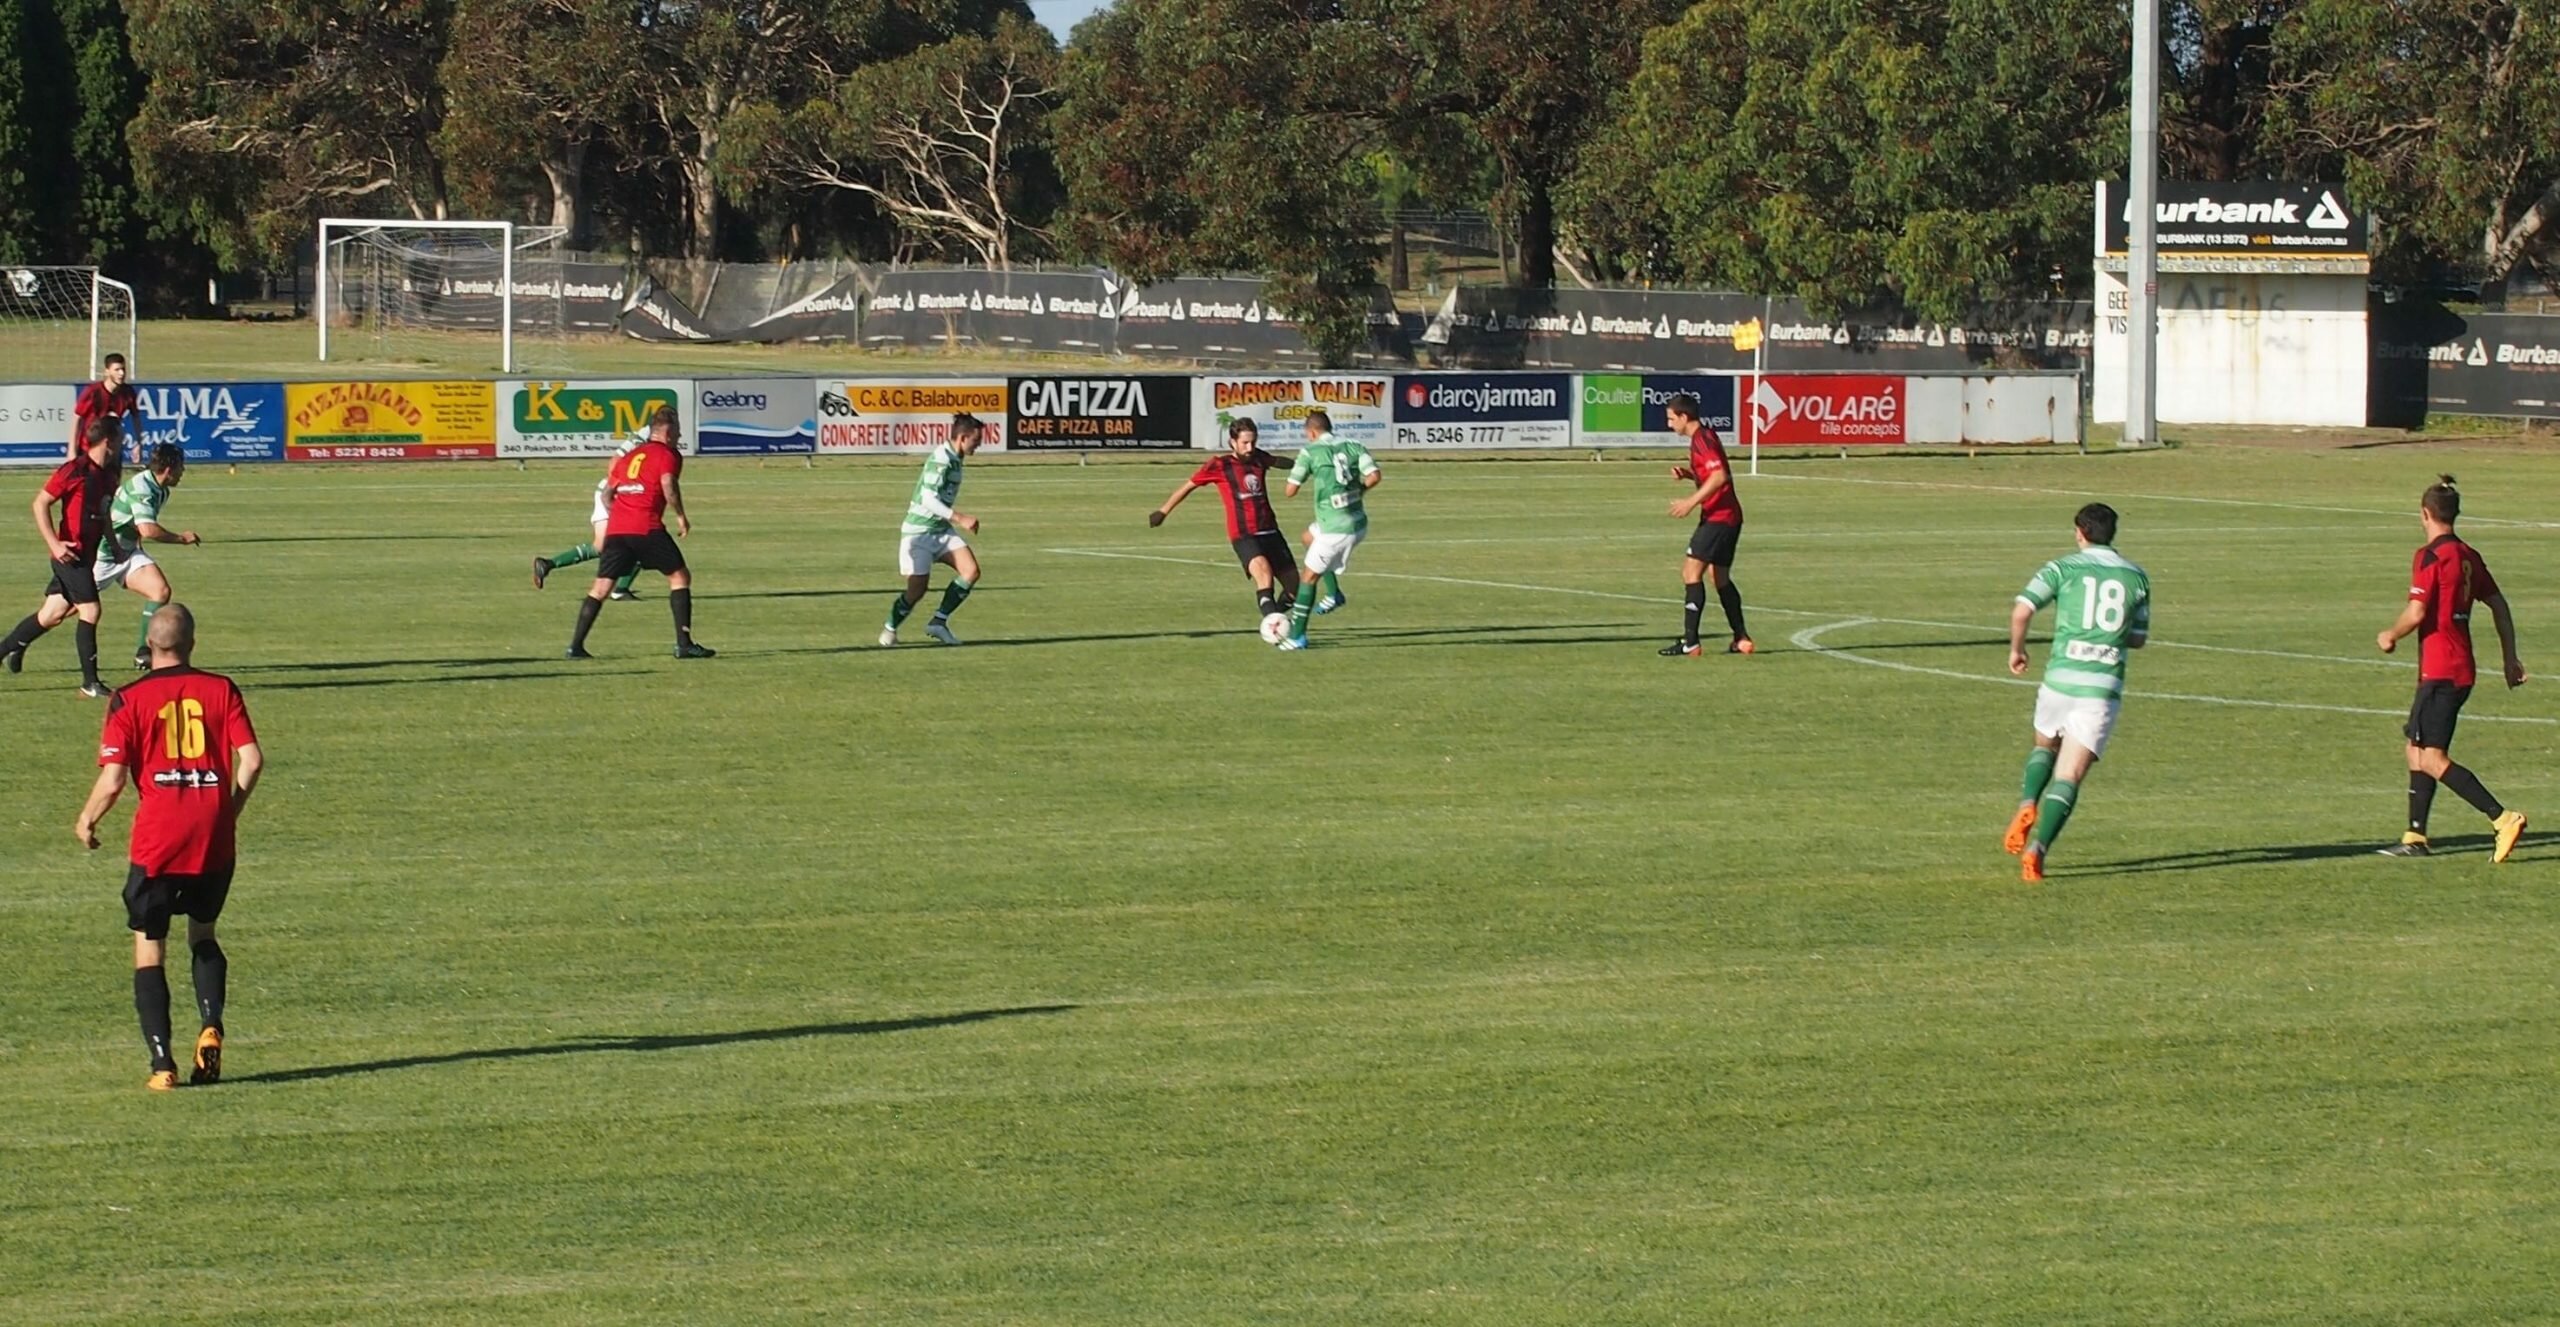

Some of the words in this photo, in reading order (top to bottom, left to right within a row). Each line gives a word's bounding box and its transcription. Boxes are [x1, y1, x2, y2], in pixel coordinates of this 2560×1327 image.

[2123, 197, 2300, 223] urbank
[564, 283, 611, 298] Burbank
[918, 293, 968, 309] Burbank
[985, 294, 1030, 311] Burbank
[1049, 297, 1098, 315] Burbank
[1189, 302, 1246, 319] Burbank
[1590, 315, 1653, 335] Burbank
[1770, 322, 1833, 341] Burbank
[2496, 344, 2560, 365] Burba
[136, 387, 247, 419] ALMA
[524, 381, 569, 421] K
[577, 399, 604, 420] &
[702, 391, 766, 410] Geelong
[861, 390, 876, 407] C.
[879, 390, 890, 406] &
[892, 390, 908, 407] C.
[911, 390, 1000, 407] Balaburova
[1017, 380, 1148, 416] CAFIZZA
[1214, 380, 1304, 409] BARWON
[1310, 380, 1386, 407] VALLEY
[1429, 382, 1556, 412] darcyjarman
[1584, 386, 1637, 405] Coulter
[20, 408, 65, 422] GATE
[295, 384, 422, 429] PIZZALAND
[821, 424, 889, 446] CONCRETE
[1017, 419, 1053, 434] CAFE
[1060, 419, 1099, 434] PIZZA
[1104, 419, 1133, 434] BAR
[1334, 421, 1386, 434] partments
[1398, 428, 1420, 443] Ph.
[1427, 427, 1464, 443] 5246
[1469, 427, 1504, 442] 7777
[1820, 423, 1841, 435] tile
[1842, 424, 1900, 437] concepts
[627, 453, 646, 480] 6
[2082, 576, 2125, 632] 18
[158, 698, 206, 759] 16
